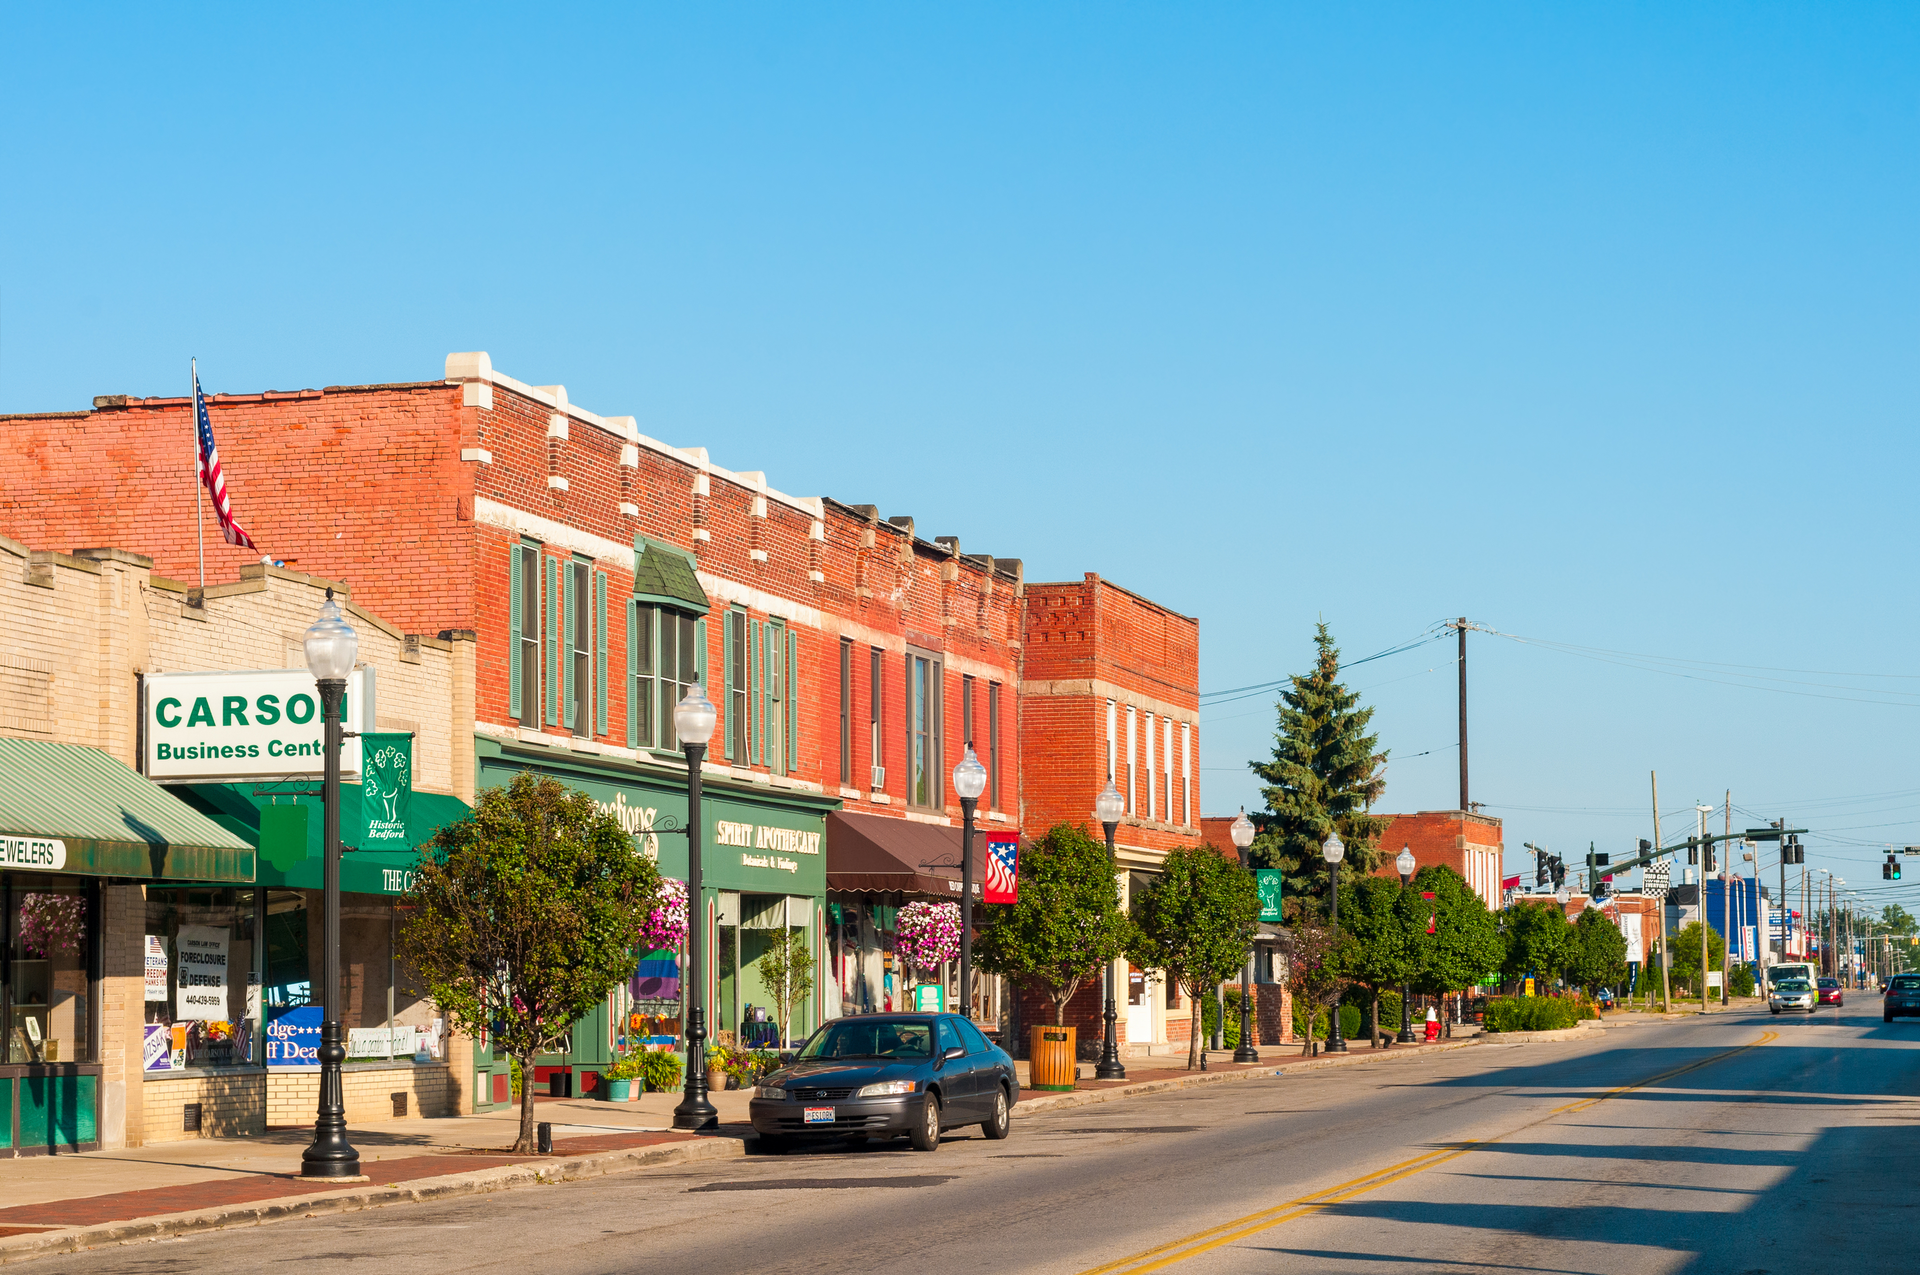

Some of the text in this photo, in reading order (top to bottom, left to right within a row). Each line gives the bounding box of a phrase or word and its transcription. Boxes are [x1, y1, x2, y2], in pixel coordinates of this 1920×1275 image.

[157, 738, 345, 760] Business Cent
[368, 820, 405, 829] Historic
[368, 829, 405, 840] Bedford
[716, 820, 821, 855] SPIRIT APOTHECARY
[382, 869, 402, 891] THE
[145, 956, 168, 966] ETERANS
[180, 951, 226, 966] FORECLOSURE
[145, 968, 167, 979] REEDOM
[188, 973, 221, 988] DEFENSE
[282, 1041, 320, 1059] Dea
